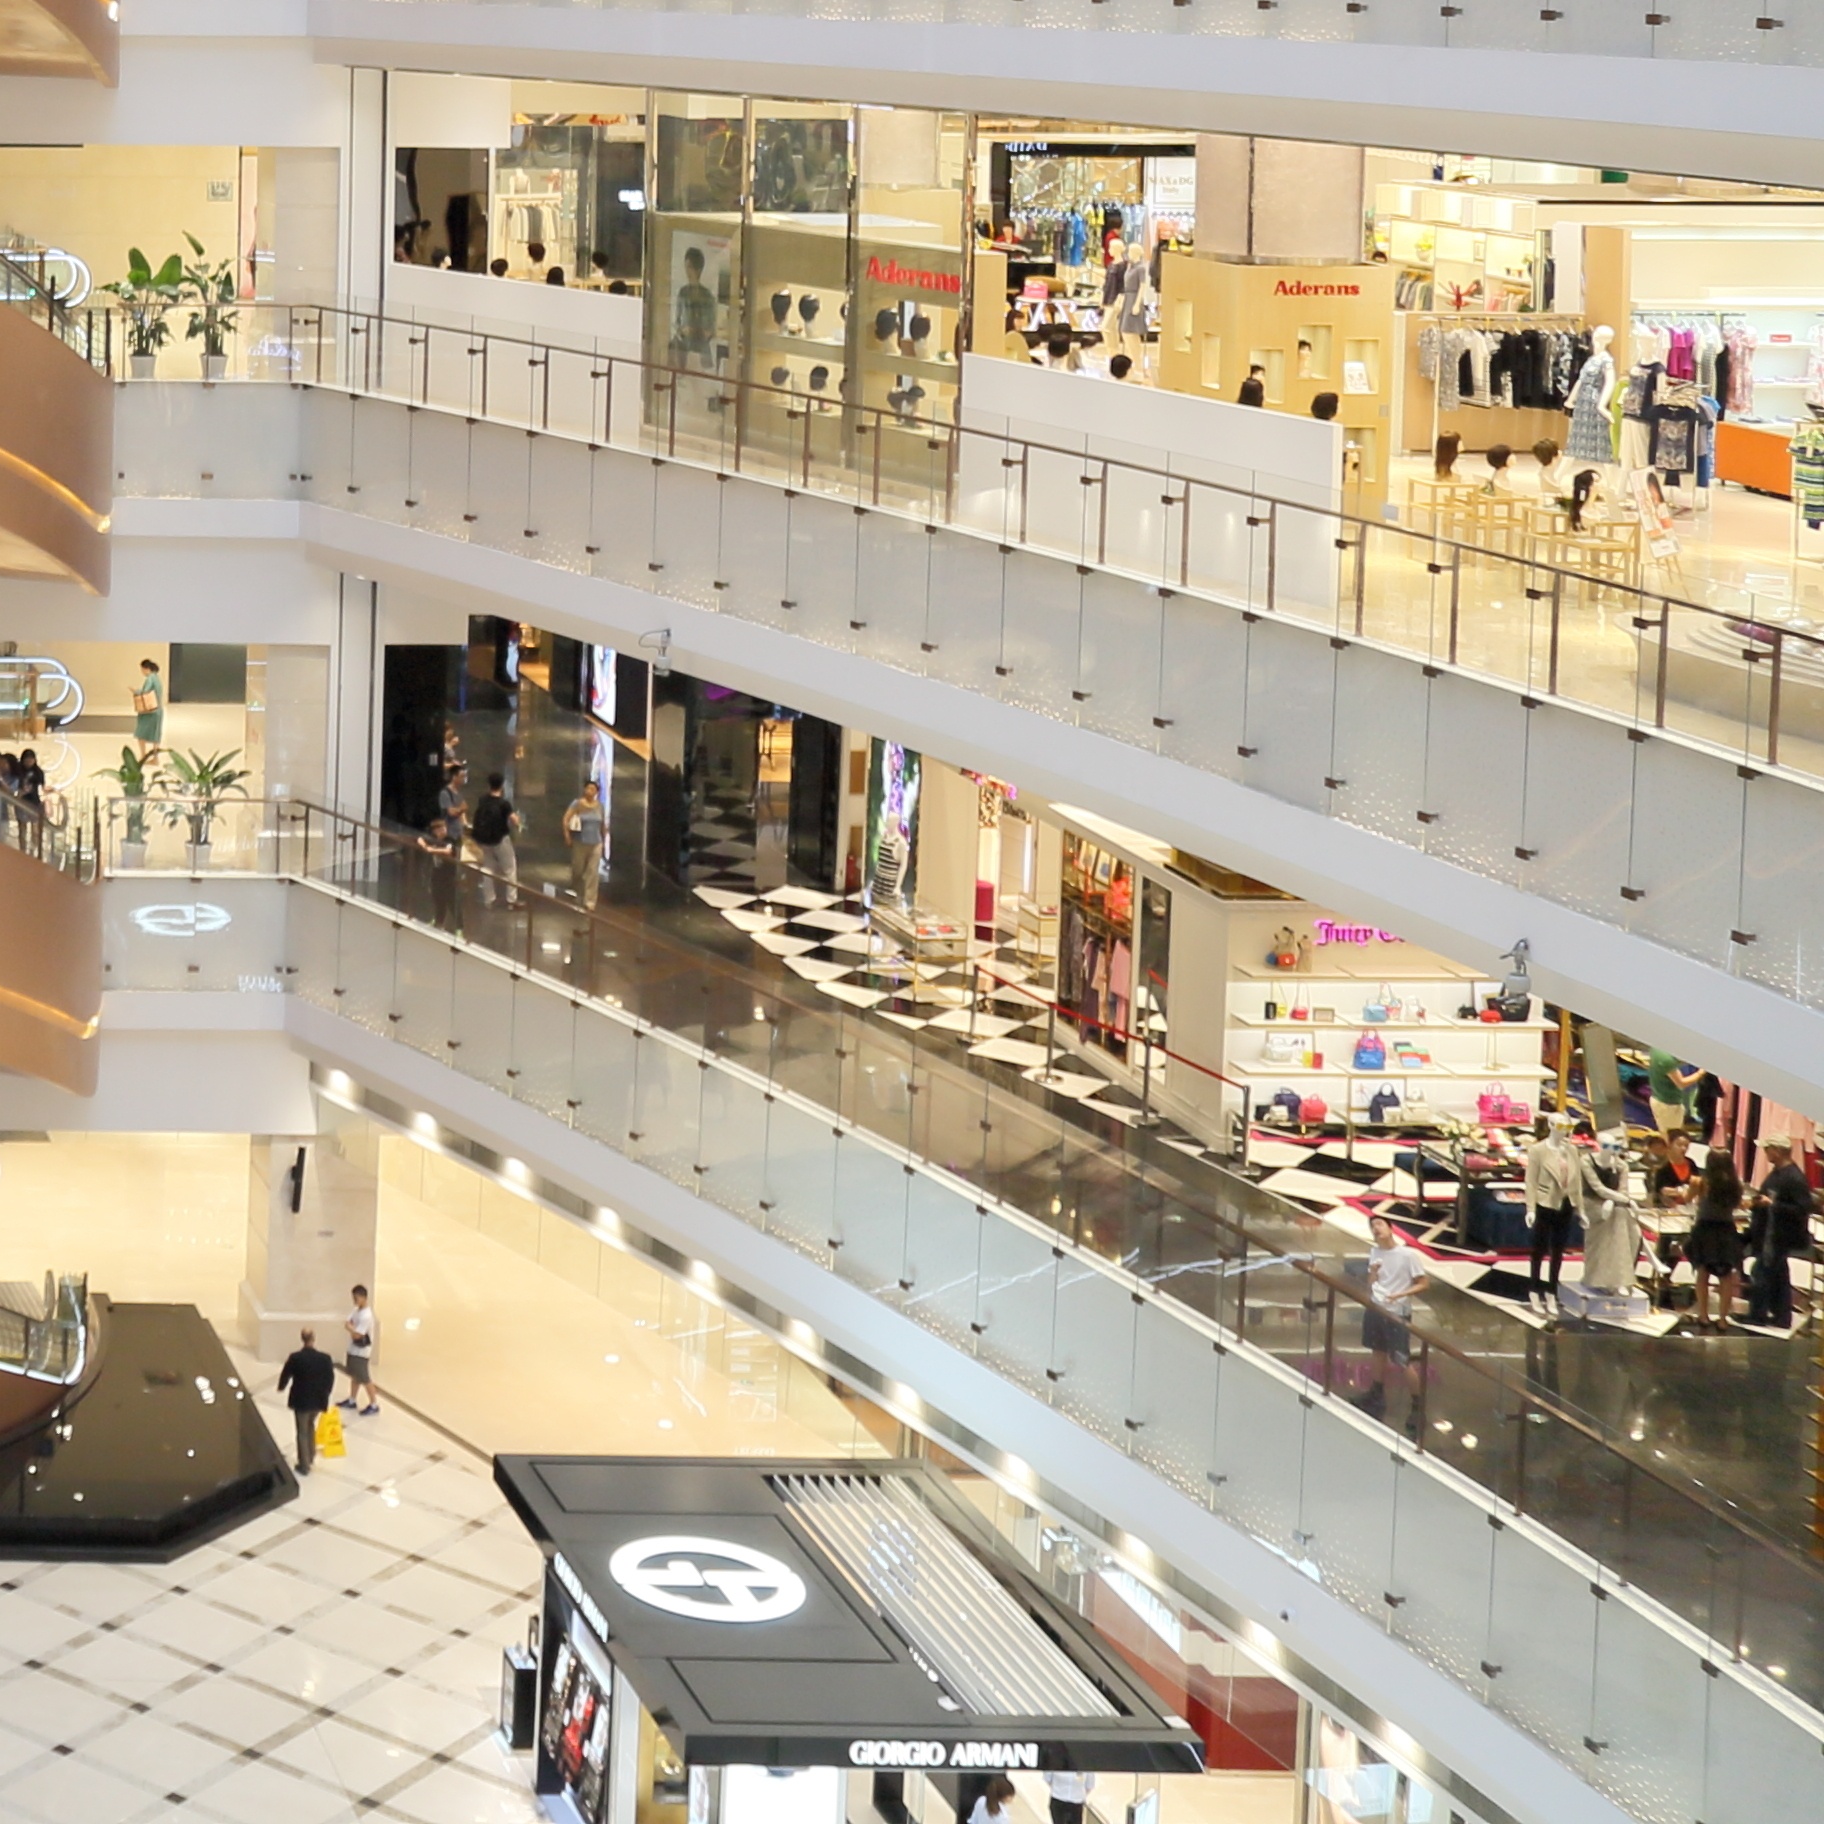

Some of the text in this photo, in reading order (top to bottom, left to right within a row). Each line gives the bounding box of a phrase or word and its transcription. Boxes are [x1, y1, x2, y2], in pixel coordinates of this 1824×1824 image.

[866, 255, 960, 295] Aderans
[1274, 280, 1360, 297] Aderans
[1313, 919, 1373, 947] Juicy
[849, 1740, 1039, 1768] GIORGIO ARMANI
